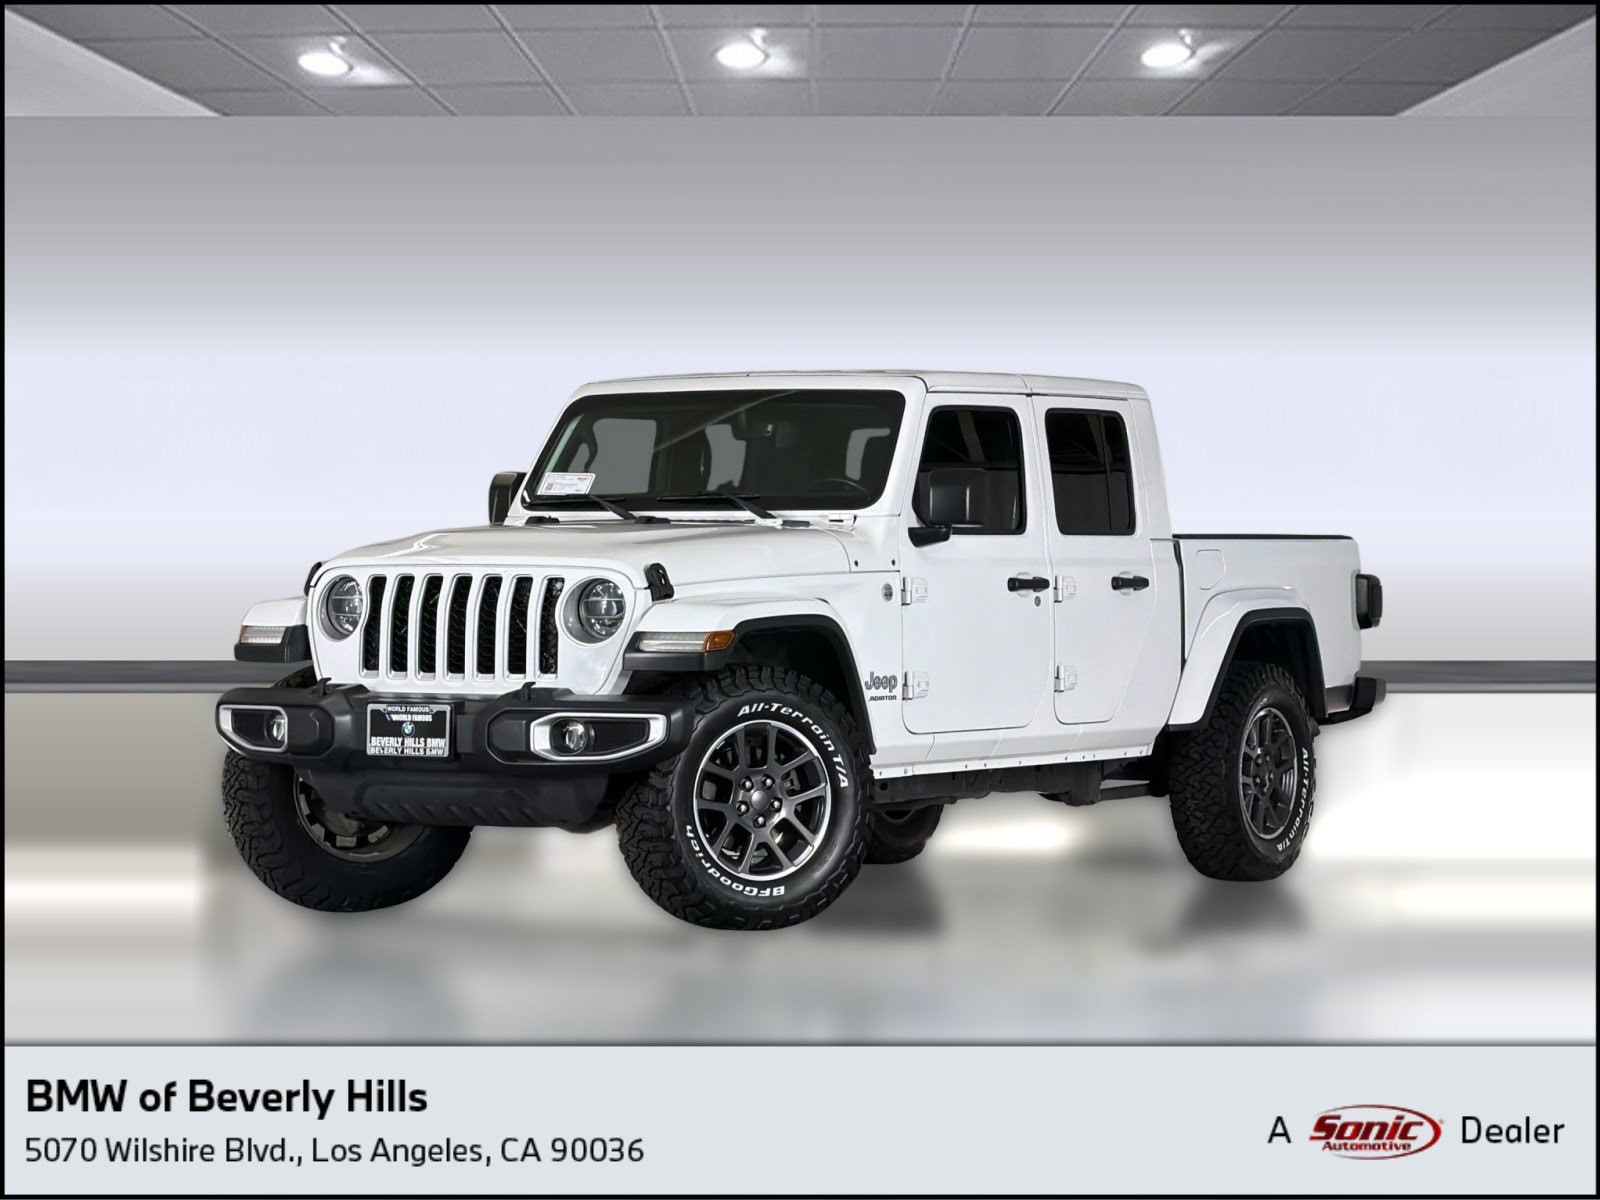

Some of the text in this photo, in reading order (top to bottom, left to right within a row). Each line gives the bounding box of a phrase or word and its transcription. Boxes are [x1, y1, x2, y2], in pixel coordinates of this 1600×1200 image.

[864, 671, 898, 693] Jeep
[370, 746, 403, 754] BEVERLY
[403, 747, 425, 755] HILLS
[371, 737, 446, 748] BEVERLY HILLS BMW
[737, 702, 849, 788] All-Terrain T/A
[1276, 746, 1310, 852] All-Terrain T/A
[685, 824, 785, 898] BFGoodrich
